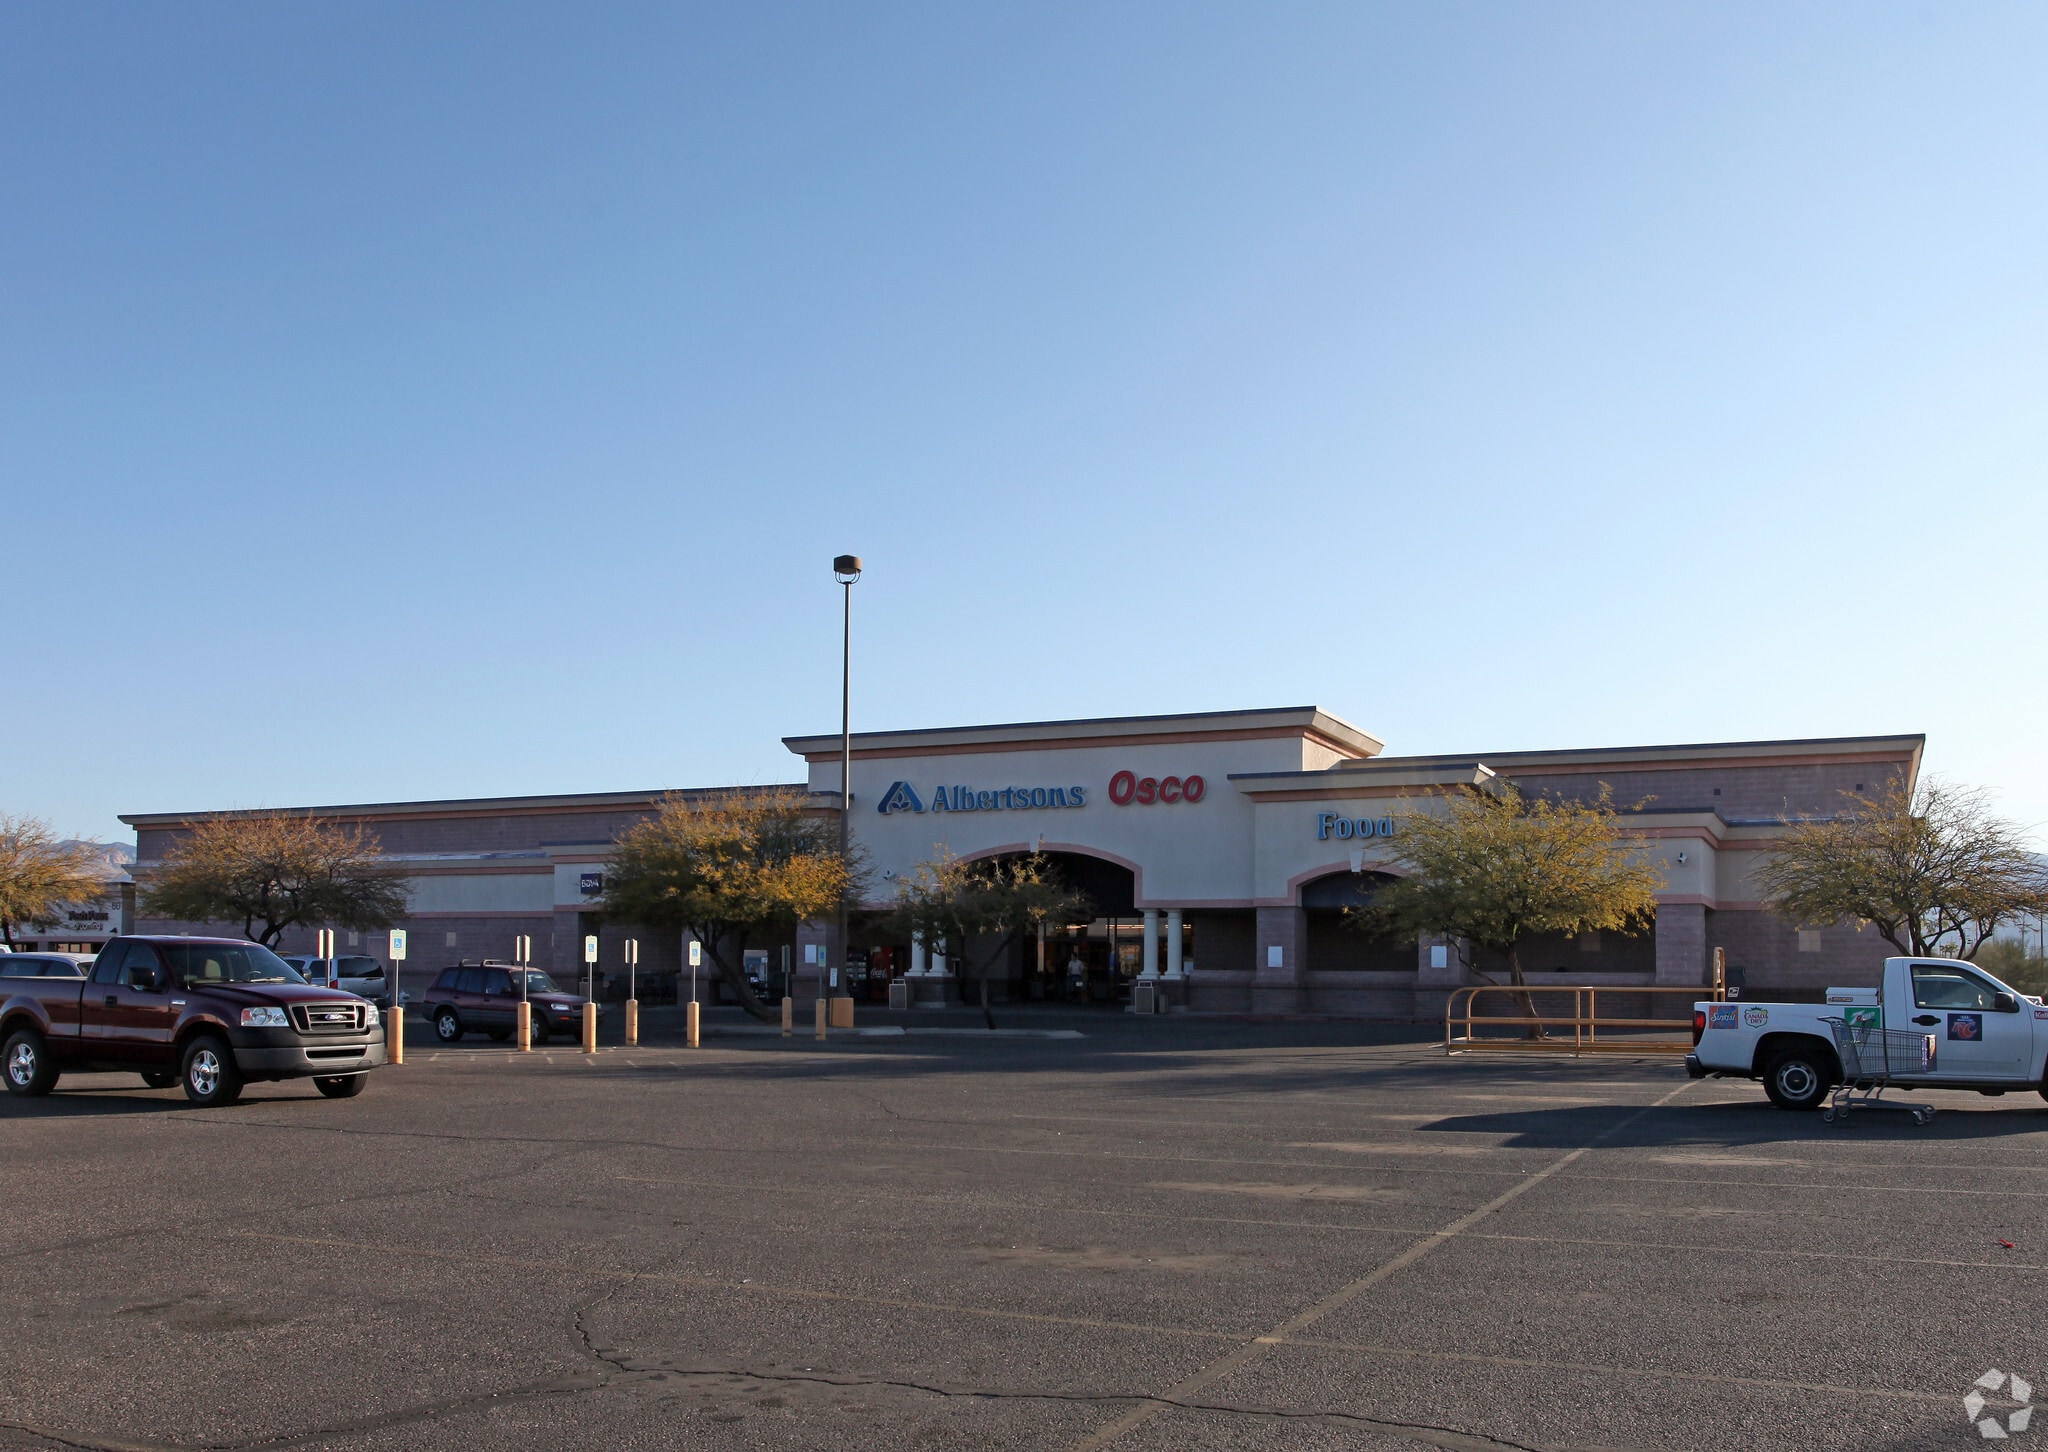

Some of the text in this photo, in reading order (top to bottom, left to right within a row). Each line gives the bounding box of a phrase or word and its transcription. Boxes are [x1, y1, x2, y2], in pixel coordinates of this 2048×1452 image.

[931, 769, 1207, 813] Albertsons Osco
[1316, 811, 1394, 841] Food
[1744, 1012, 1769, 1021] CANADA
[1951, 1021, 1978, 1040] RC
